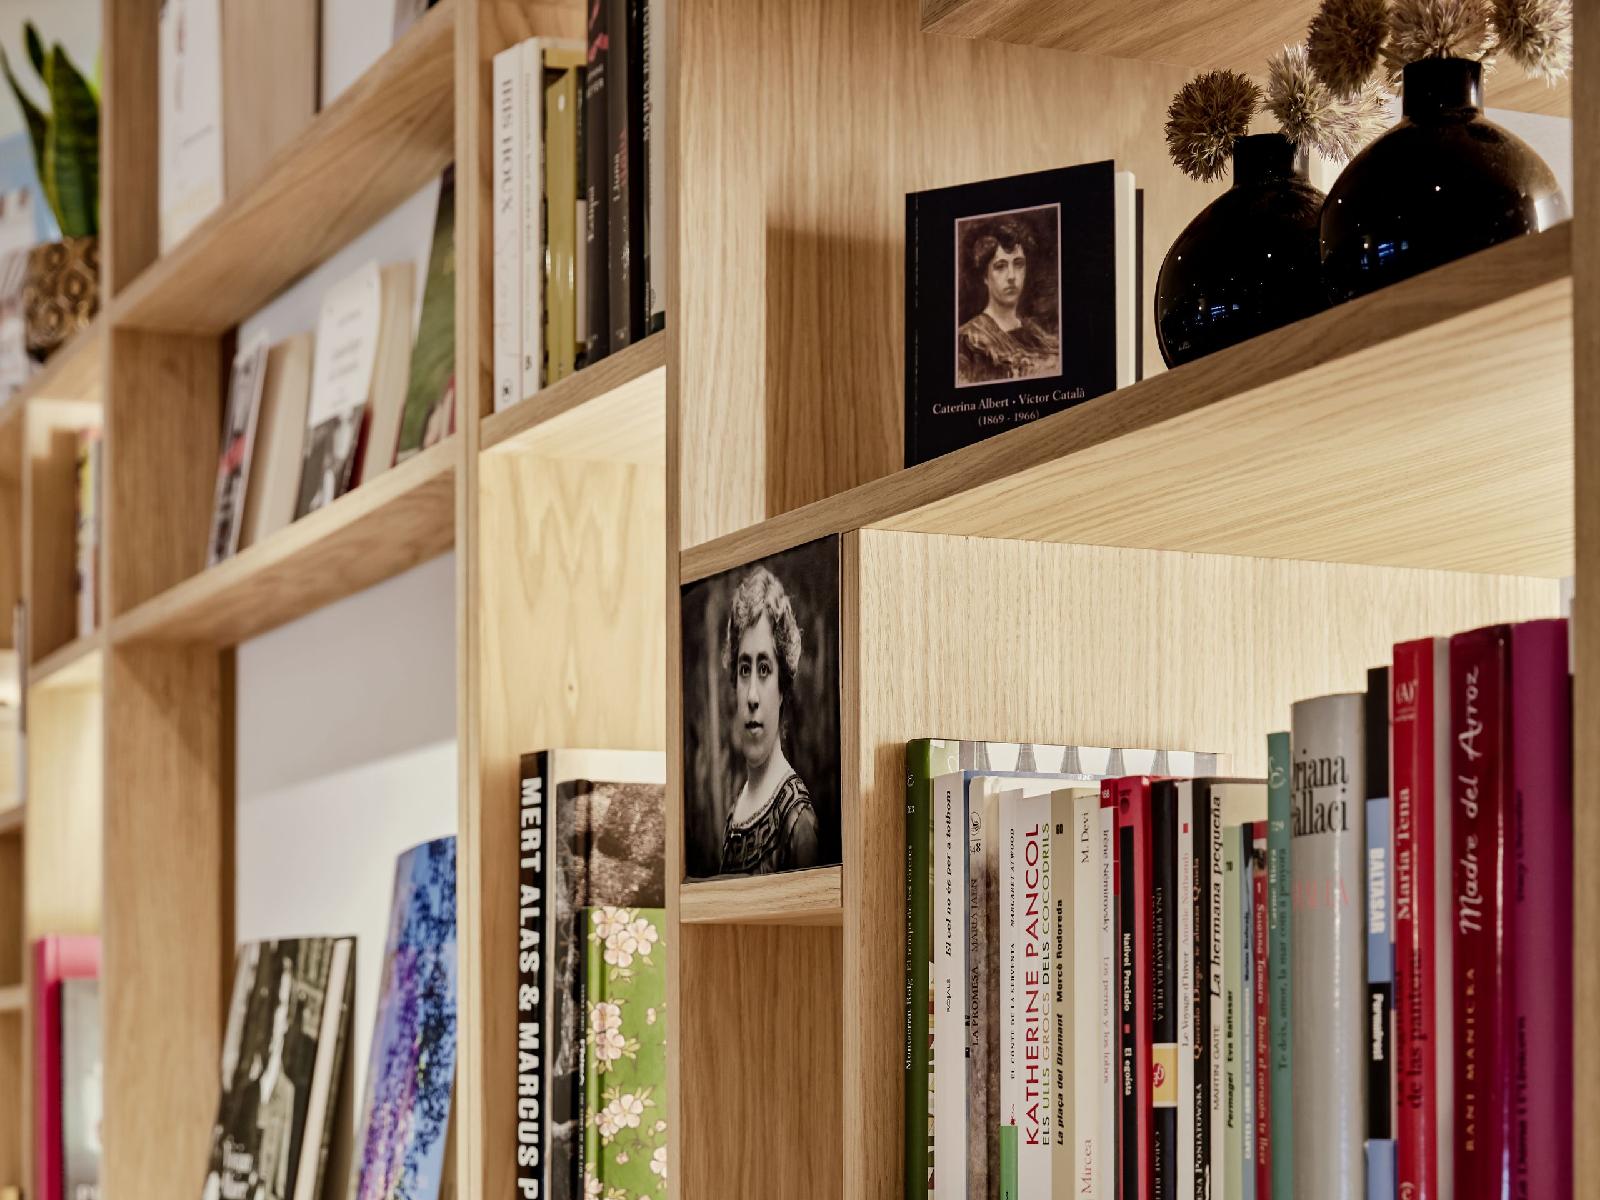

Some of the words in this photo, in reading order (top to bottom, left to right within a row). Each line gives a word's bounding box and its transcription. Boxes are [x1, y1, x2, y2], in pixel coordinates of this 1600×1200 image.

[932, 401, 976, 415] Caterina
[978, 396, 1009, 410] Albert
[1052, 387, 1085, 401] Català
[978, 413, 1004, 427] (1869
[1014, 410, 1040, 422] 1966)
[1458, 665, 1483, 761] Arroz
[944, 791, 952, 839] tothom
[1394, 788, 1408, 848] Tena
[1458, 775, 1479, 818] del
[518, 776, 542, 872] MERT
[1080, 811, 1090, 845] Devi
[1209, 797, 1224, 876] pequeña
[946, 855, 954, 875] per
[1041, 823, 1050, 936] COCODRILS
[1458, 834, 1483, 934] Madre
[946, 899, 952, 915] no
[1024, 823, 1039, 959] PANCOL
[1369, 847, 1384, 934] BALTASAR
[518, 884, 541, 973] ALAS
[944, 918, 952, 943] cel
[1055, 900, 1063, 960] Rodoreda
[1209, 880, 1221, 968] hermana
[944, 944, 952, 957] El
[1041, 942, 1050, 986] DELS
[1123, 933, 1132, 967] Nativel
[1154, 912, 1164, 984] PRIMAVERA
[518, 983, 541, 1012] &
[970, 967, 979, 1028] PROMESA
[1055, 964, 1063, 1003] Mercè
[1123, 970, 1132, 1012] Preciado
[1153, 988, 1163, 1010] PER
[1209, 972, 1221, 999] La
[1041, 993, 1050, 1062] GROCS
[1153, 1013, 1163, 1022] A
[971, 1032, 980, 1047] LA
[1024, 970, 1040, 1146] KATHERINE
[1055, 1014, 1064, 1067] Diamant
[1123, 1047, 1132, 1058] El
[1056, 1069, 1064, 1089] del
[1122, 1062, 1132, 1096] egoísta
[1405, 1047, 1419, 1078] las
[517, 1022, 540, 1167] MARCUS
[1041, 1067, 1050, 1110] ULLS
[1041, 1117, 1050, 1146] ELS
[1056, 1130, 1064, 1147] La
[1195, 1083, 1204, 1175] PONIATOWSKA
[1080, 1140, 1093, 1196] Mircea
